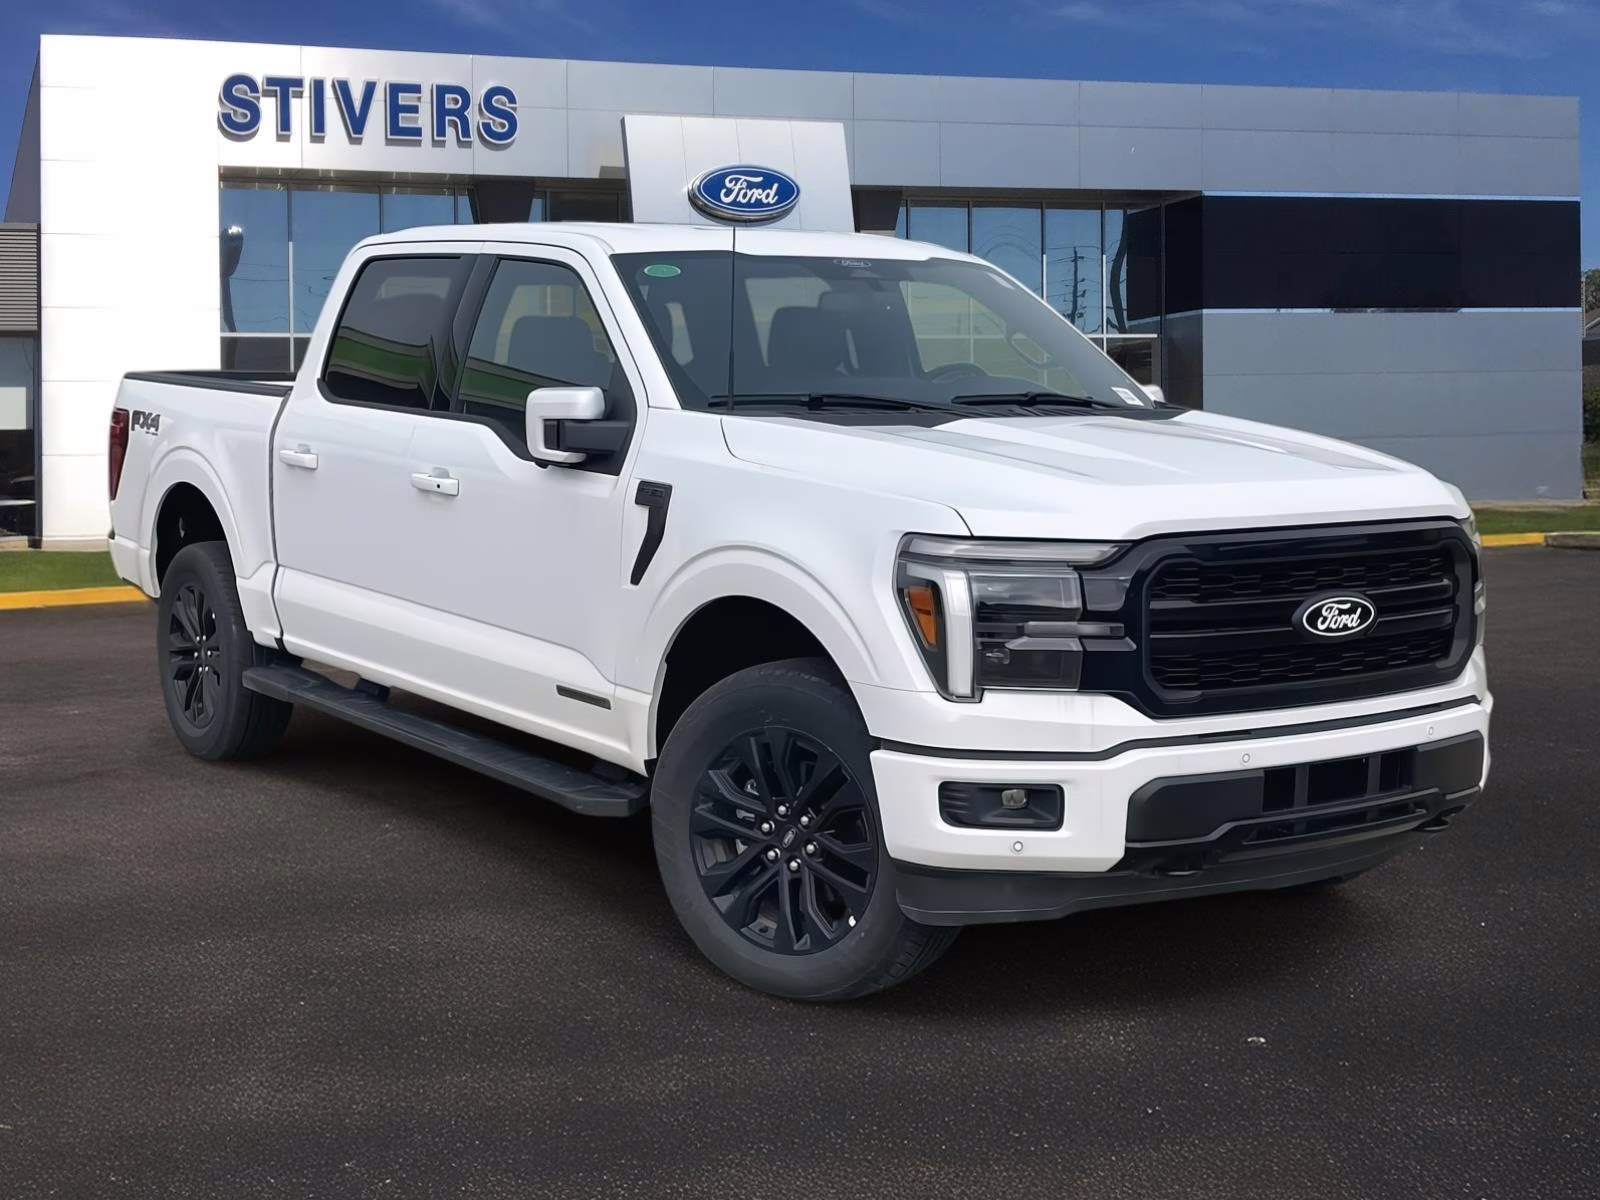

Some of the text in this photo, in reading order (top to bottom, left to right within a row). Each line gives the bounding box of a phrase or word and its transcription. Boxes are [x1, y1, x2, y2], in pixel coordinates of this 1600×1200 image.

[218, 72, 519, 147] STIVERS
[719, 174, 779, 205] Ford
[131, 409, 161, 432] FX4
[1317, 602, 1362, 631] Ford
